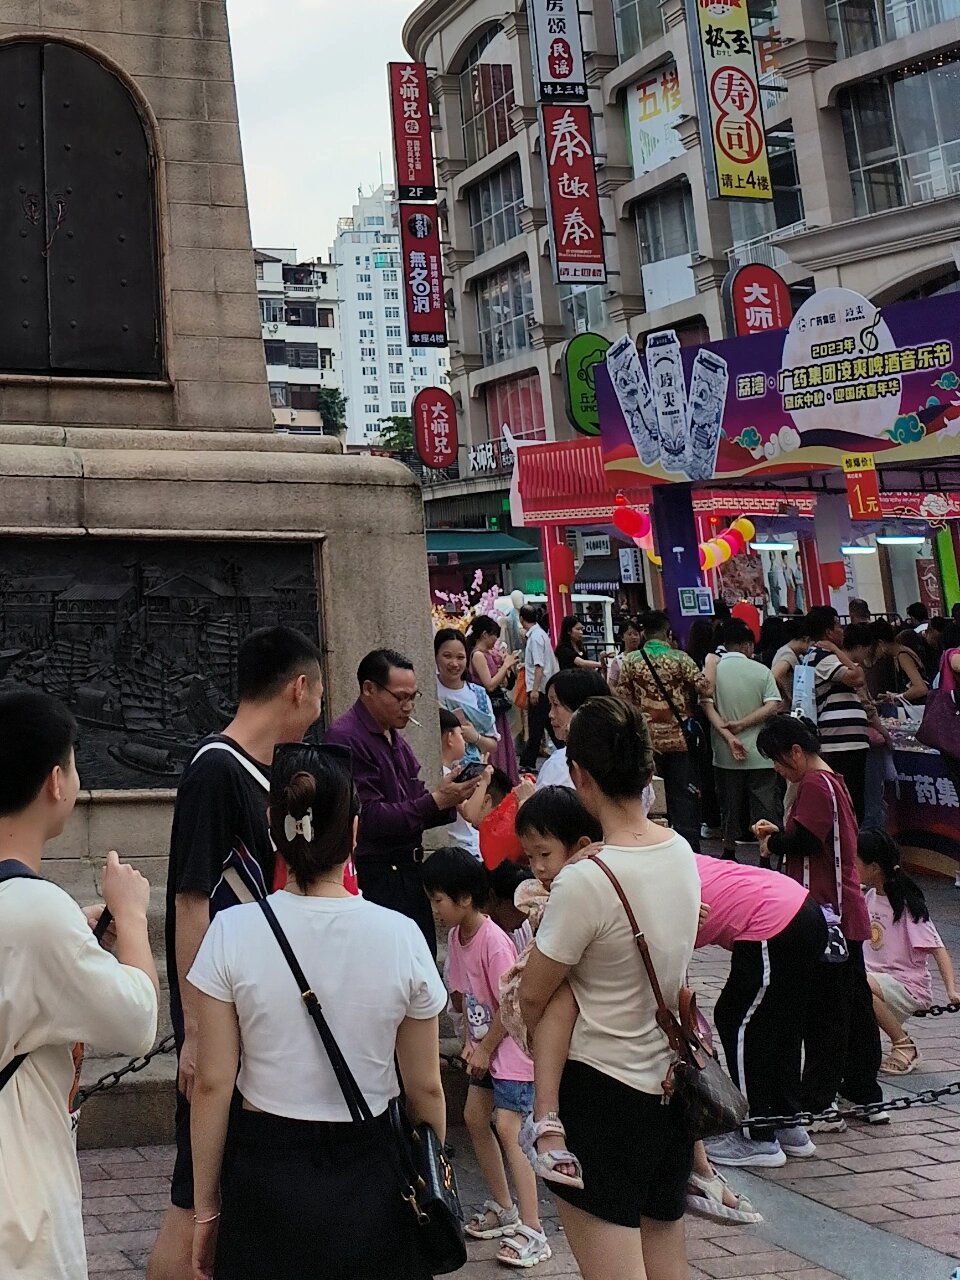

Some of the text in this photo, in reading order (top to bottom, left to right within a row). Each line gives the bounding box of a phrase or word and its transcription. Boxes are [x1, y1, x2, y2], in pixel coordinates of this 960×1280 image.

[551, 43, 569, 75] 民谣
[400, 65, 421, 118] 大师兄
[718, 73, 756, 158] 寿司
[408, 187, 424, 197] 2F
[721, 170, 770, 191] 请上4楼
[743, 282, 774, 334] 大师
[811, 338, 856, 358] 2023年
[430, 401, 452, 454] 大师兄
[853, 483, 879, 514] 1元
